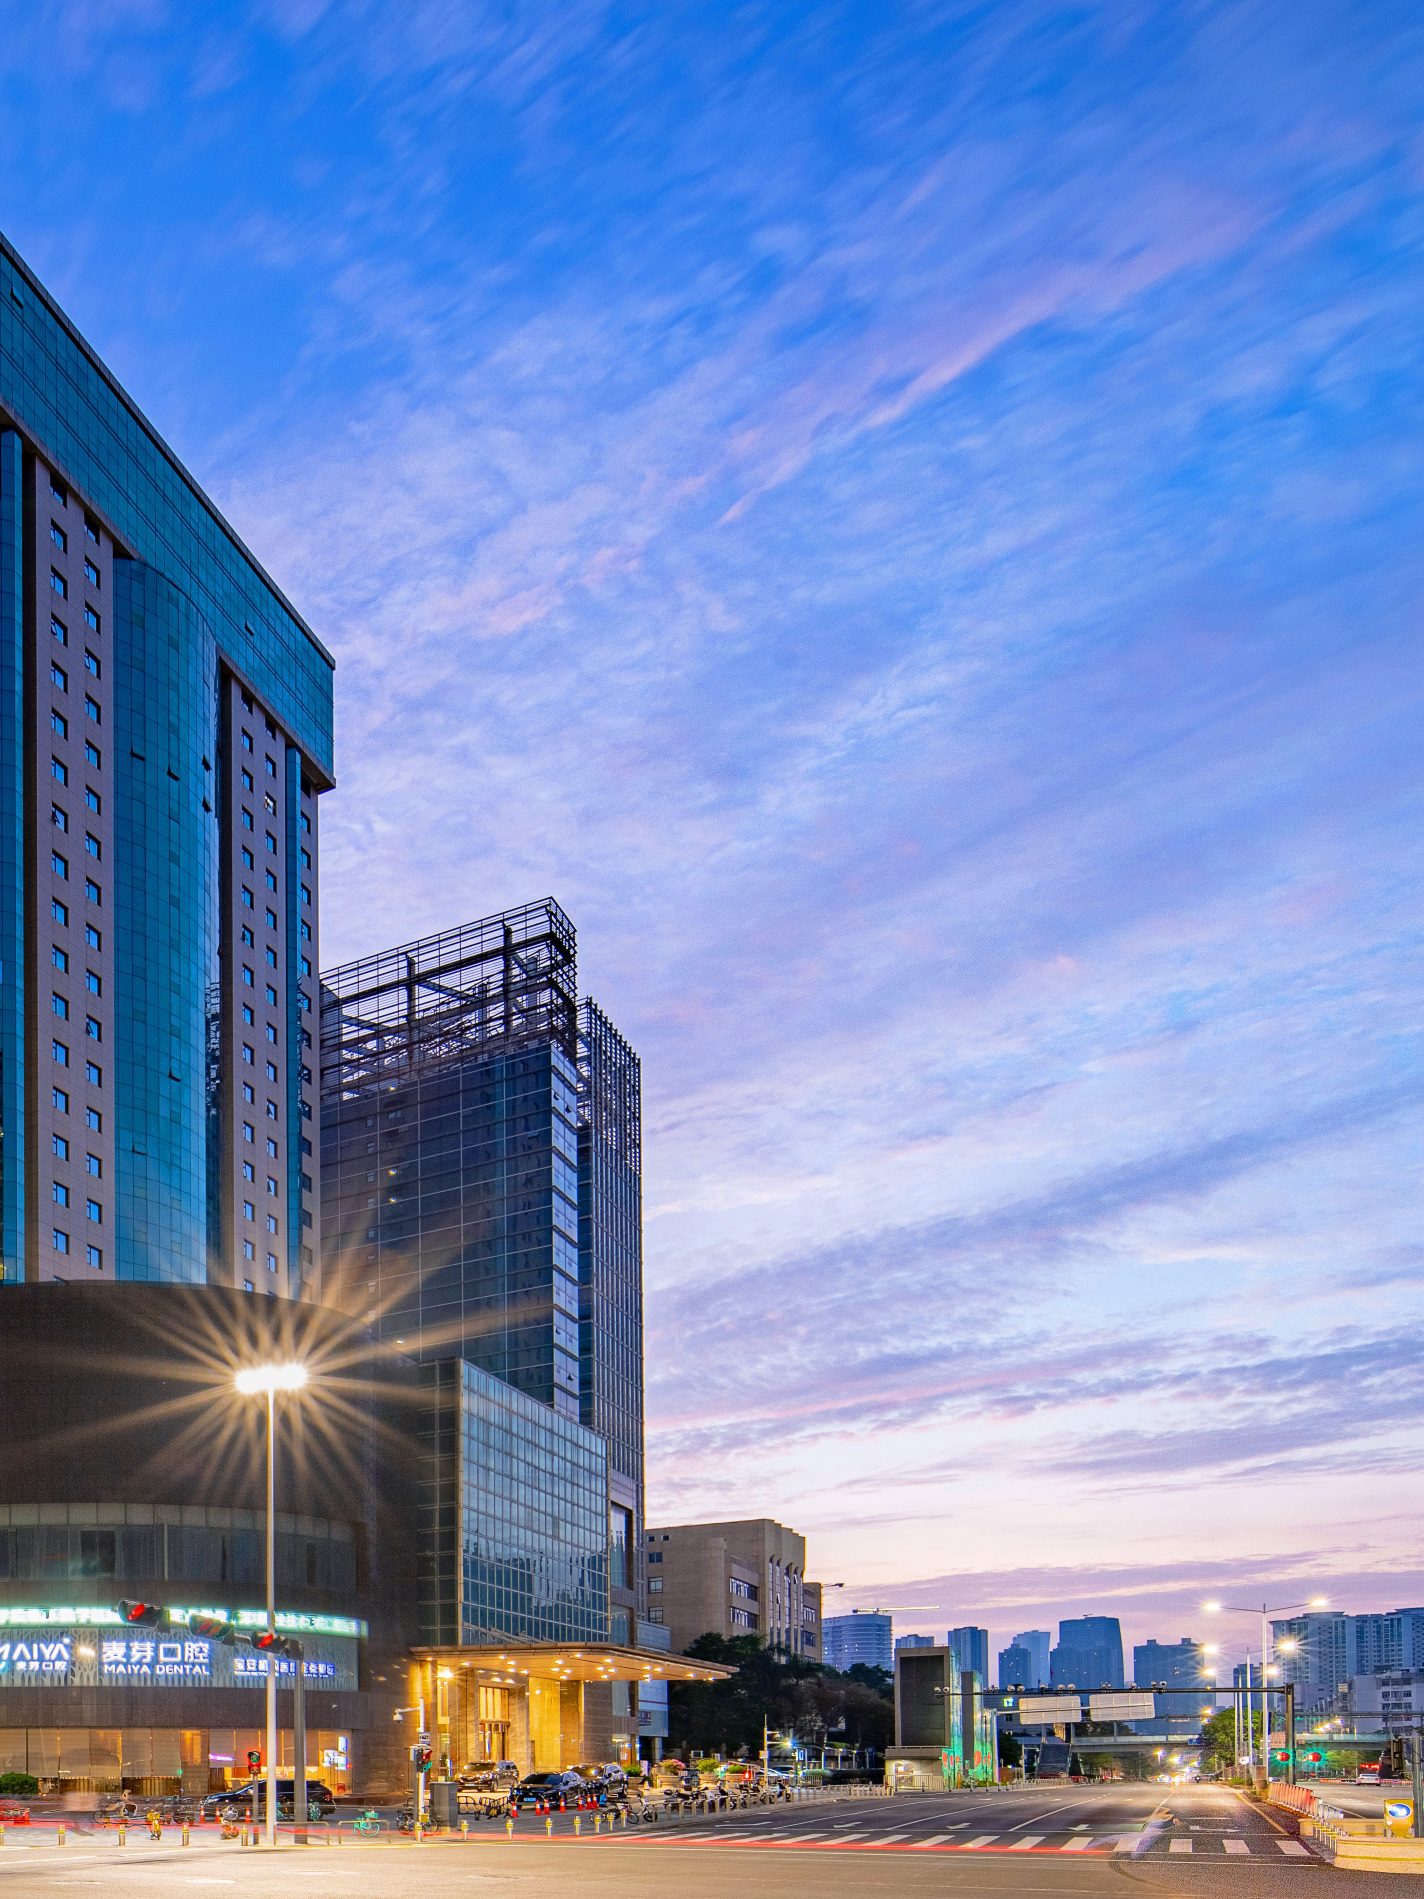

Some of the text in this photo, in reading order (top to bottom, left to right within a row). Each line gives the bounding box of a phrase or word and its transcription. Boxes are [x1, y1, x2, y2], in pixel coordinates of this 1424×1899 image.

[102, 1641, 210, 1663] 麦芽口腔
[16, 1661, 68, 1671] 麦芽口腔
[103, 1664, 210, 1675] MAIYA DENTAL
